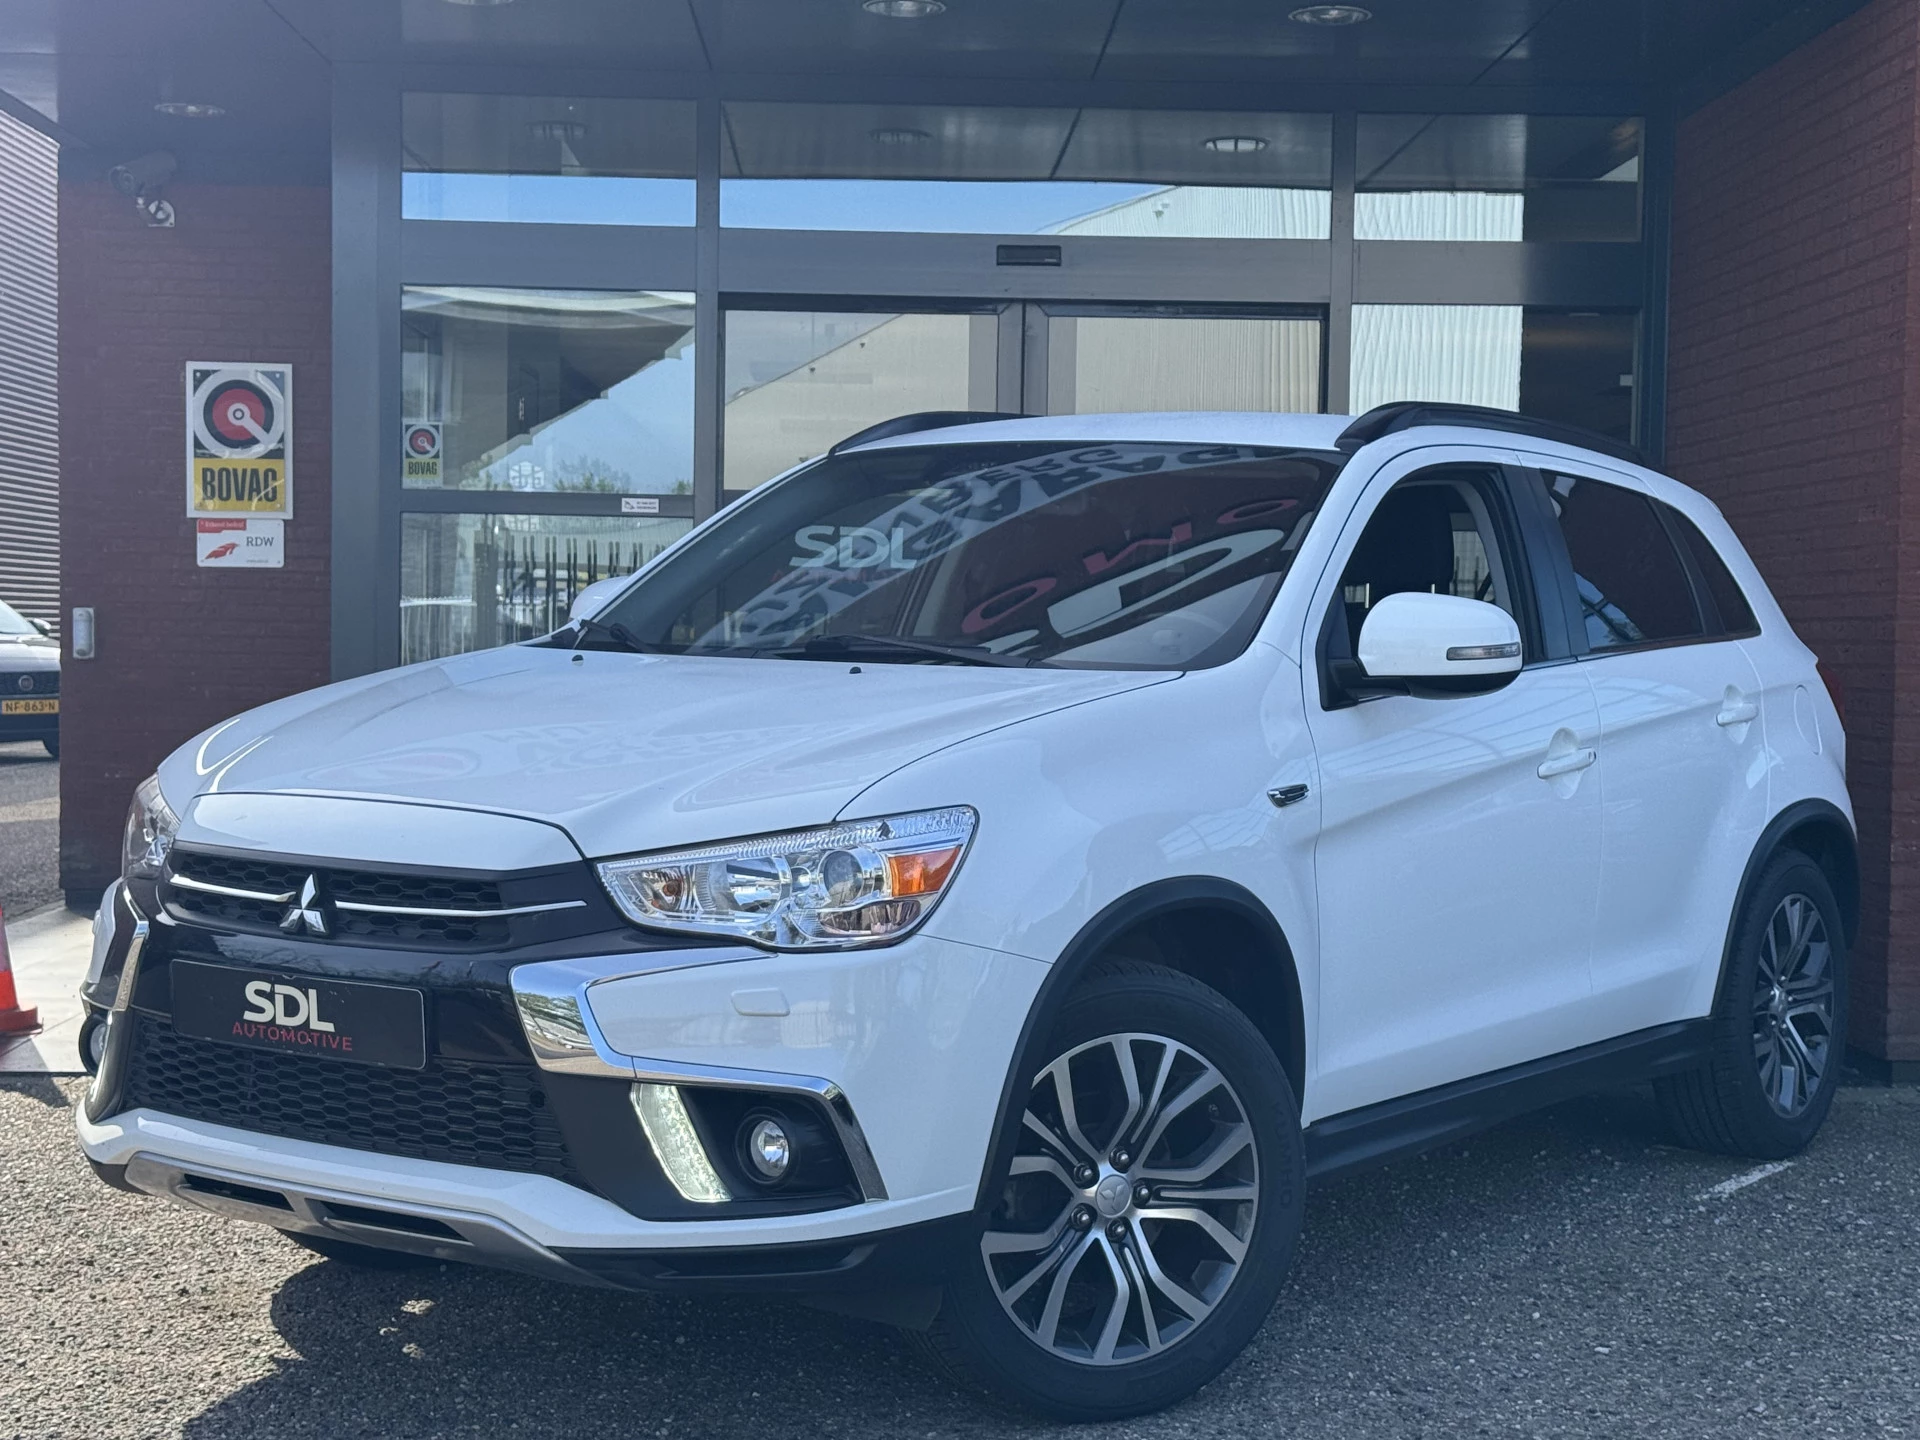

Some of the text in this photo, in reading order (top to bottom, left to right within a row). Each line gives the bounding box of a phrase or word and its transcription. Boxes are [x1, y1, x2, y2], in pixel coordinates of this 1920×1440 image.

[408, 461, 438, 475] BOVAG
[202, 467, 278, 502] BOVAG
[246, 536, 275, 547] RDW
[789, 525, 918, 569] SDL
[243, 980, 336, 1032] SDL
[232, 1021, 353, 1051] AUTOMOTIVE
